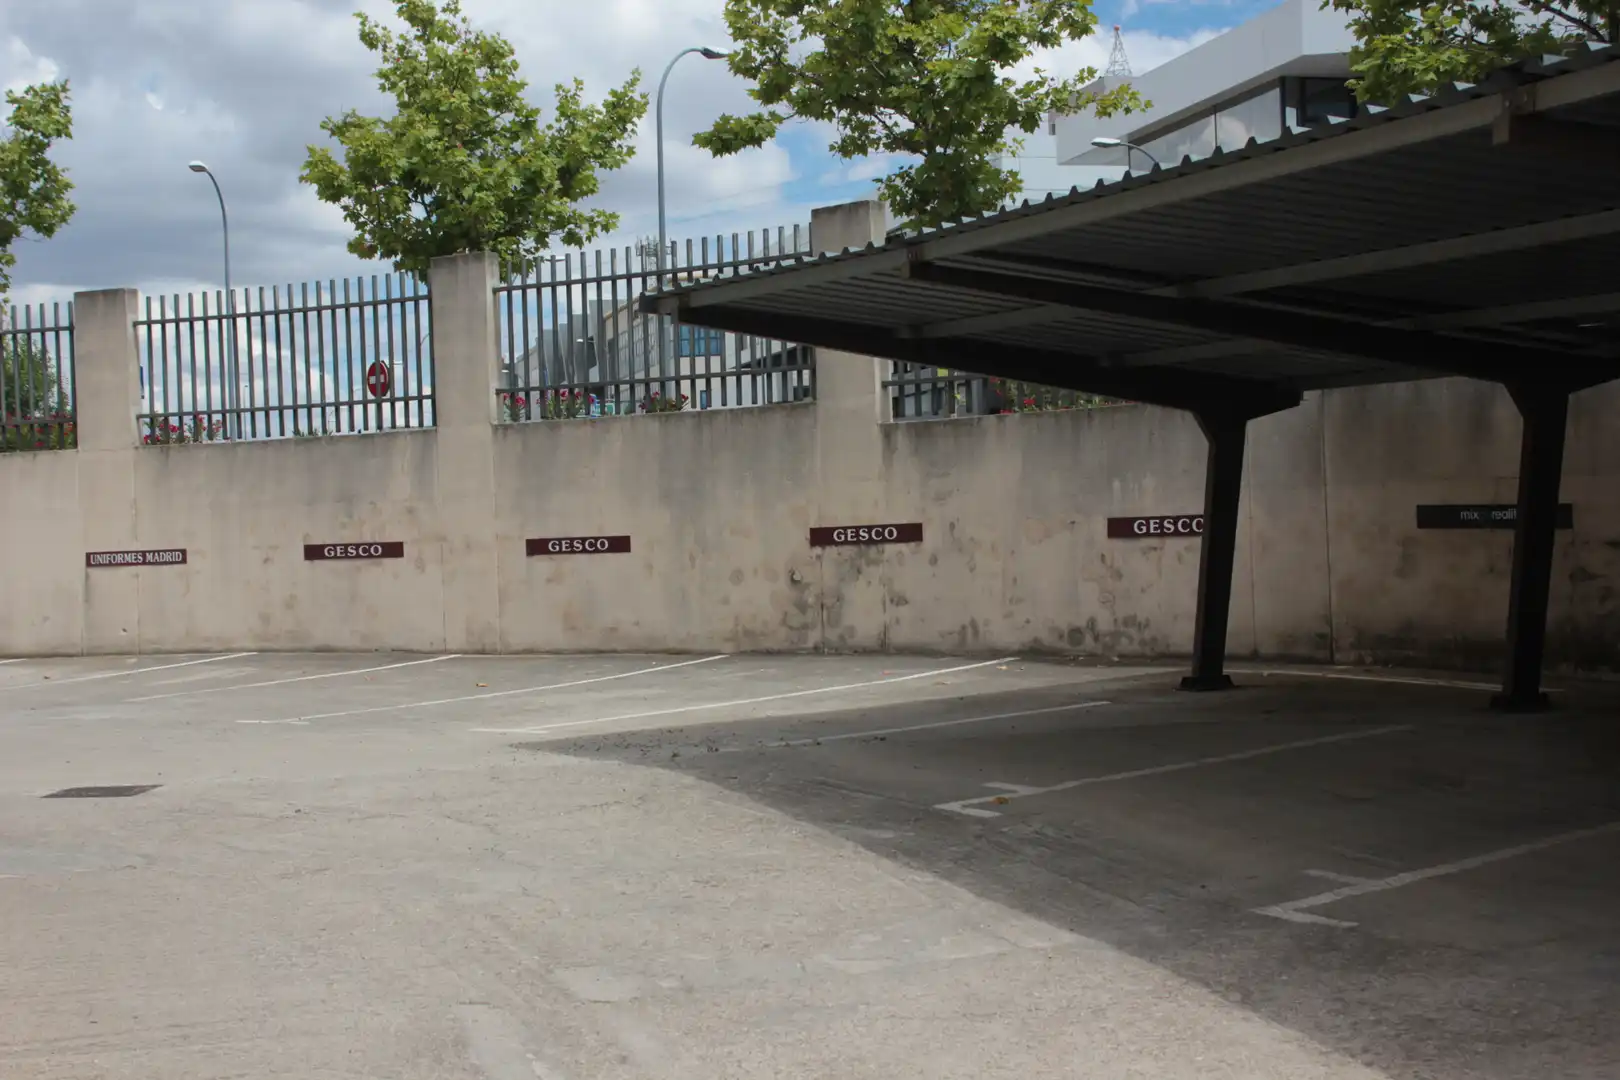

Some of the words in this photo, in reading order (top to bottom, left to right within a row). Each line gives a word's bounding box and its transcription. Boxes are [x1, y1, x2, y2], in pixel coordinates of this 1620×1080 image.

[1460, 508, 1480, 520] mix
[1491, 508, 1517, 521] realit
[1133, 518, 1204, 534] GESCO
[833, 526, 898, 542] GESCO
[324, 544, 382, 557] GESCO
[548, 539, 609, 552] GESCO
[90, 553, 143, 565] UNIFORMES
[145, 551, 183, 563] MADRID
